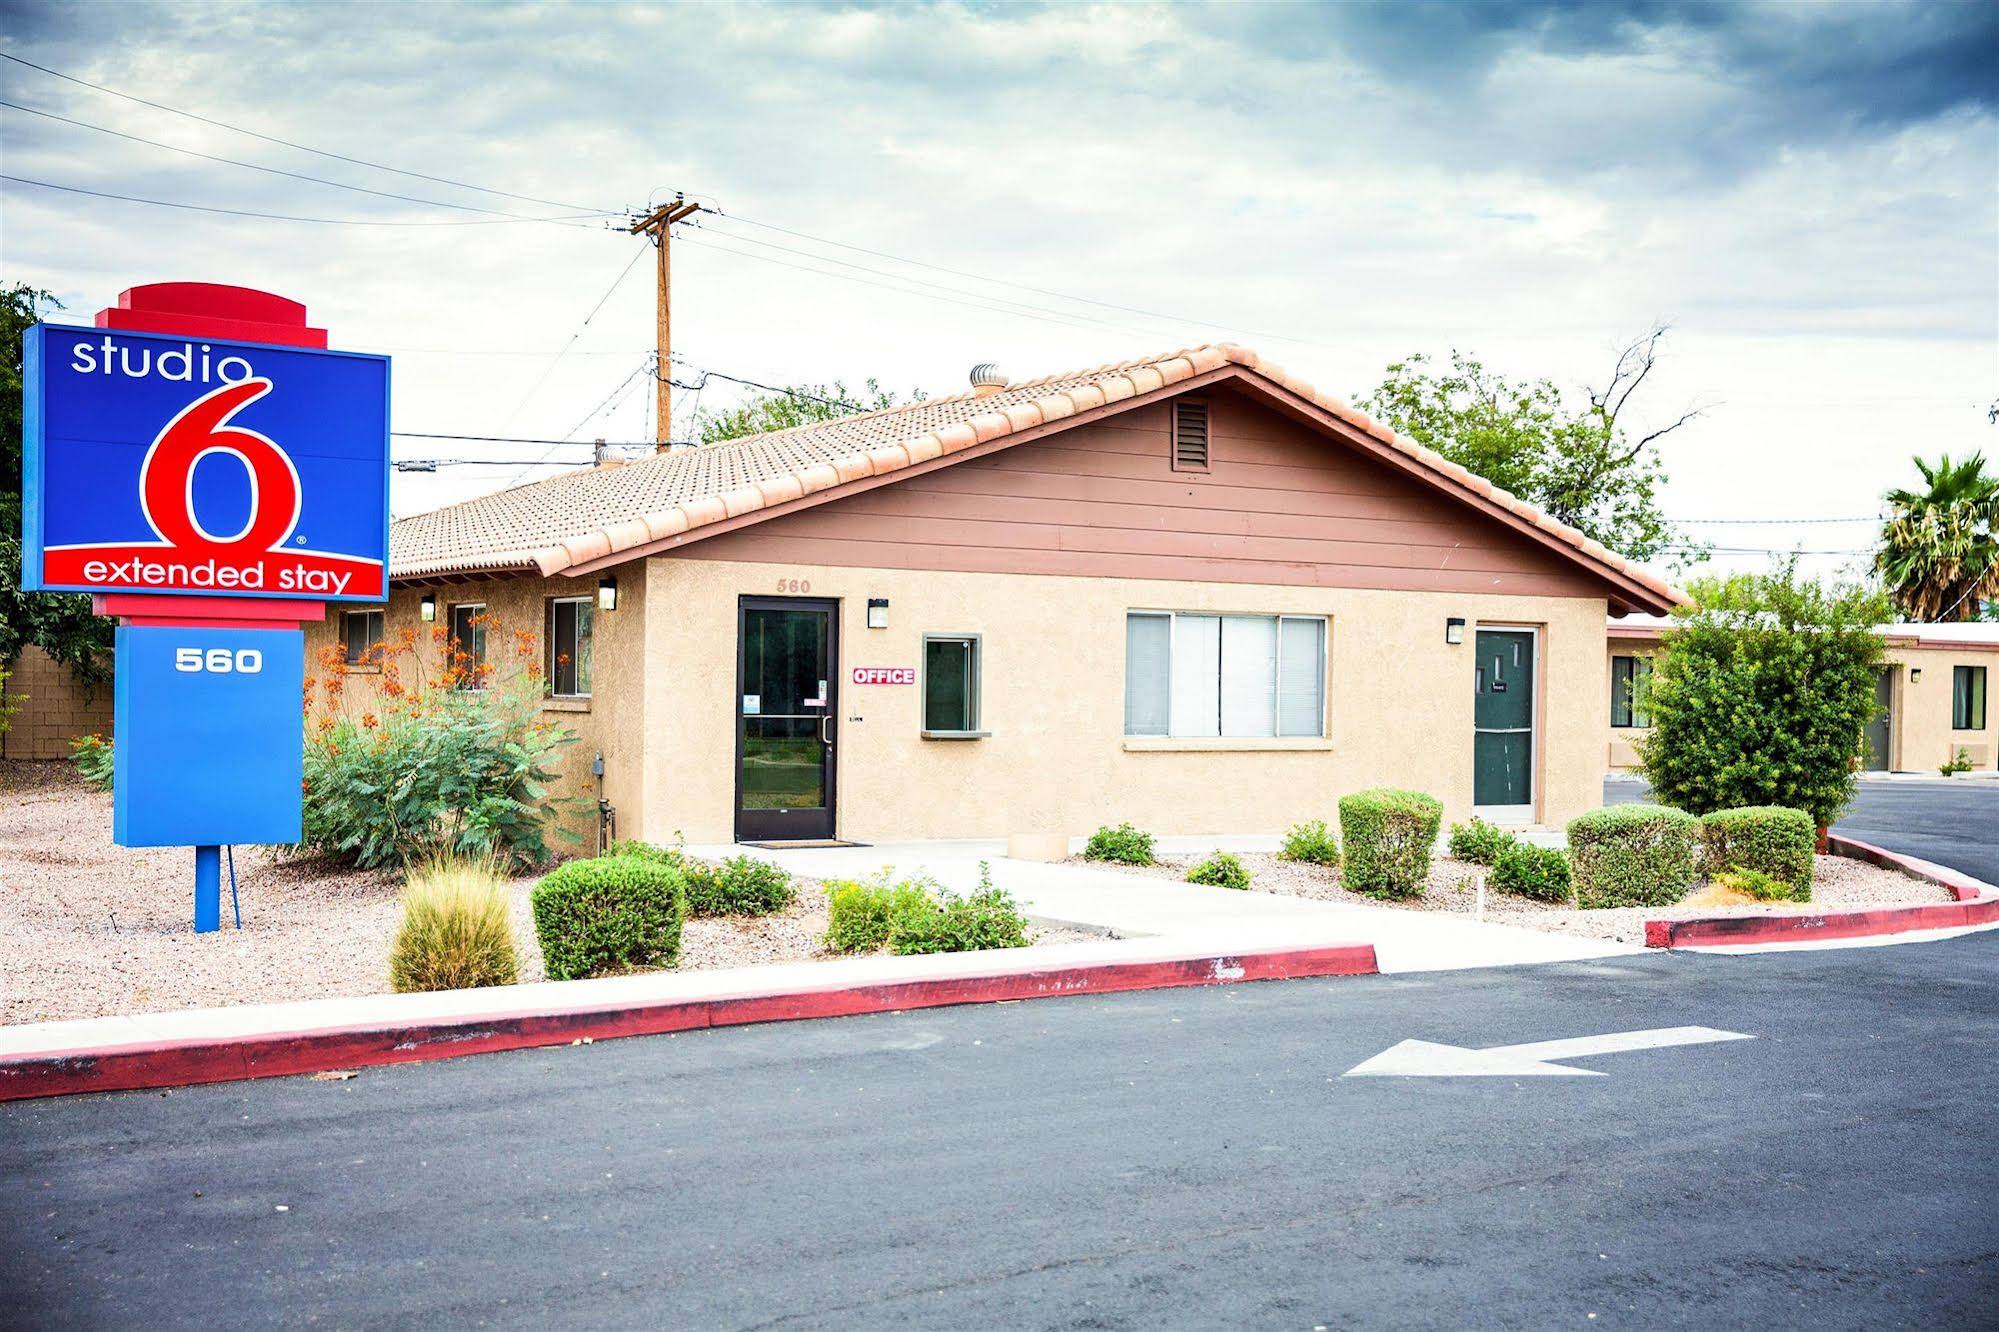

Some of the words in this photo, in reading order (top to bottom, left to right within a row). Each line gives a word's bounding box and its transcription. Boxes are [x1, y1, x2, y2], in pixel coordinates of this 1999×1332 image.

[71, 336, 253, 385] studio
[139, 376, 302, 549] 6
[84, 557, 264, 588] extended
[279, 564, 352, 596] stay
[776, 579, 811, 594] 560
[175, 647, 263, 674] 560
[854, 669, 914, 684] OFFICE
